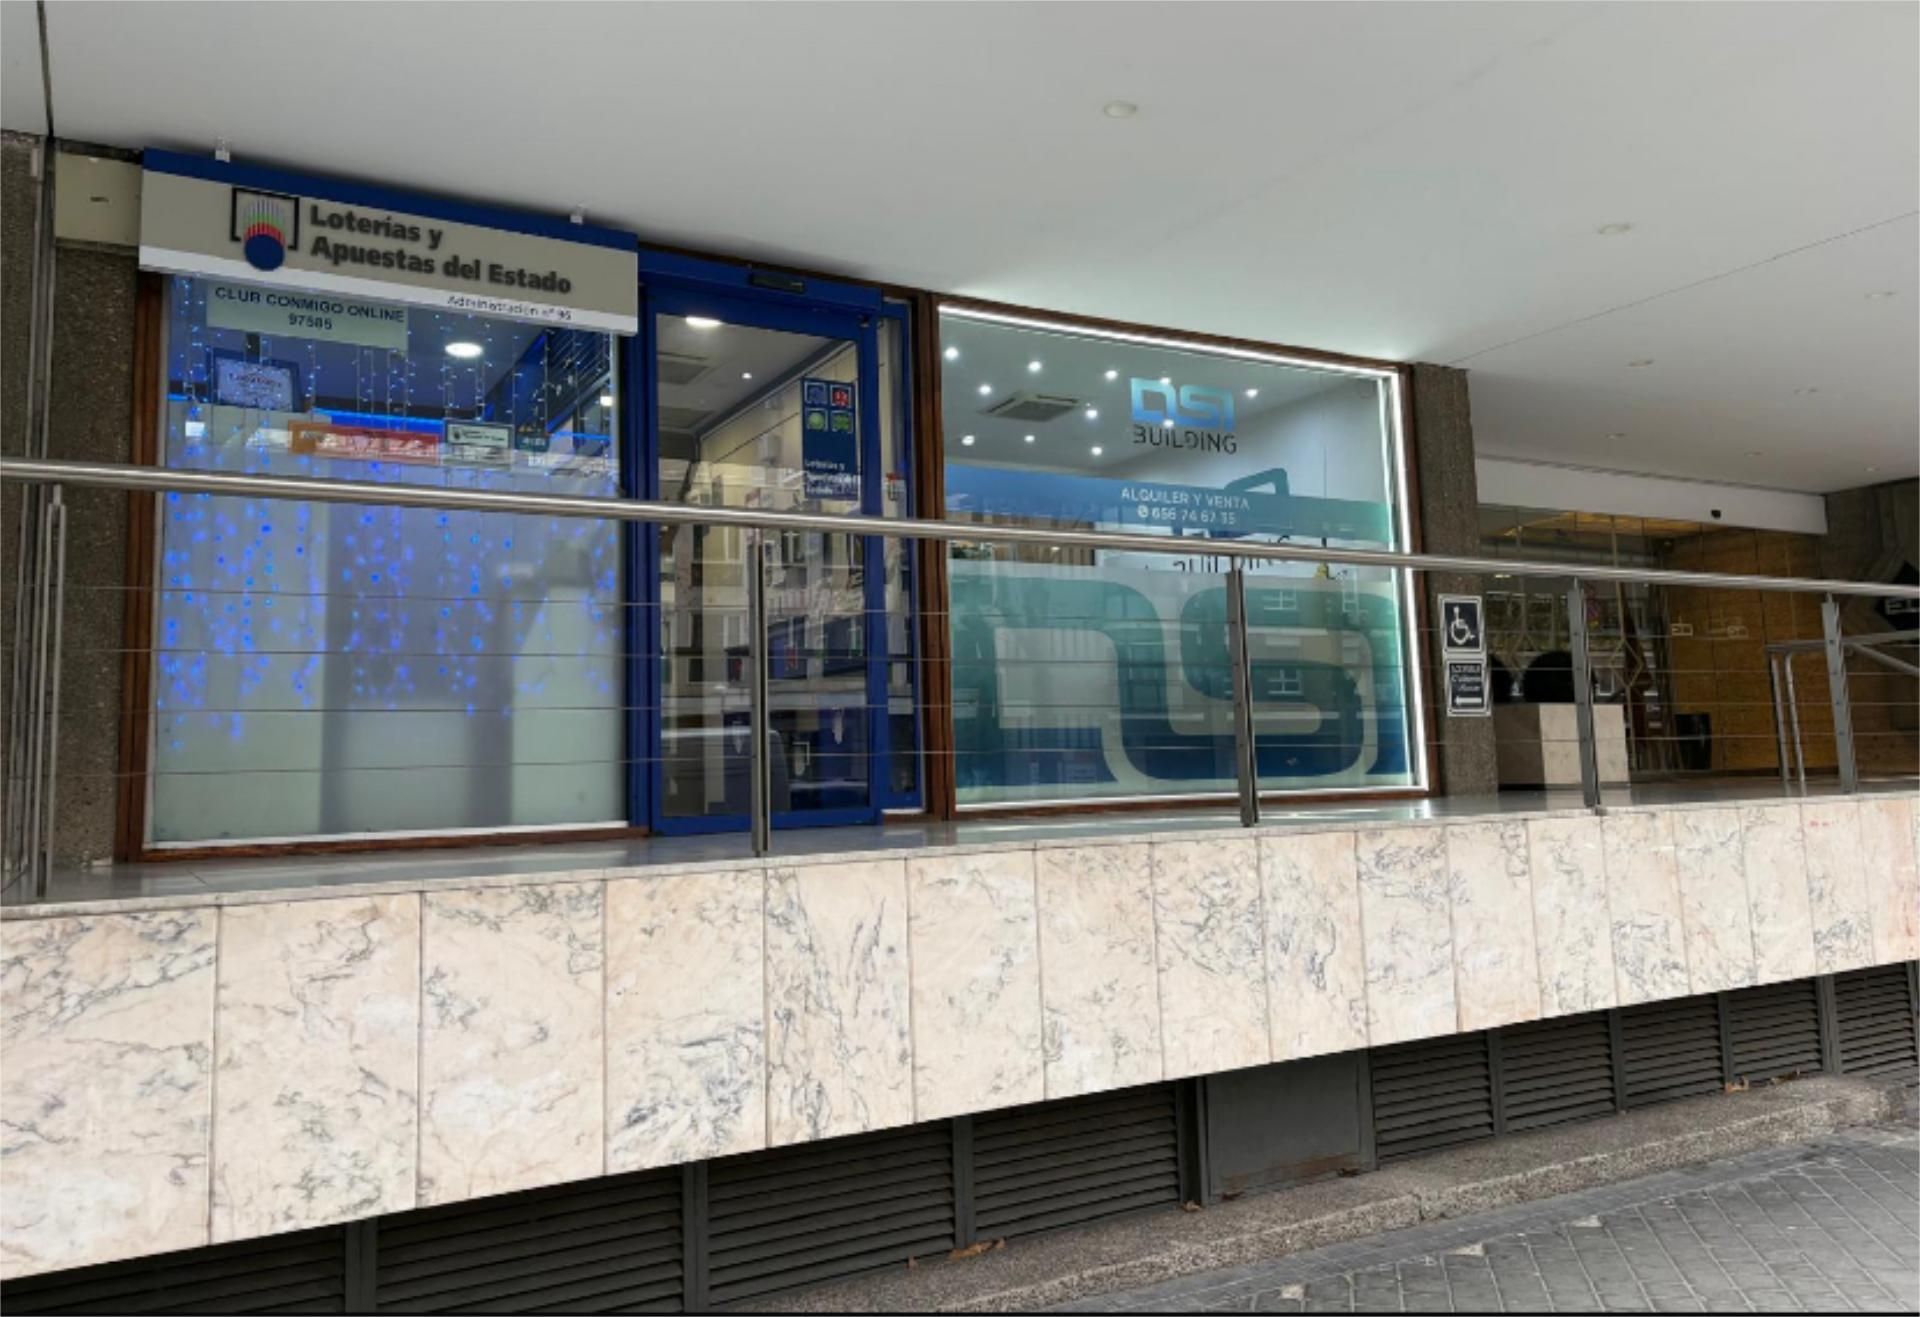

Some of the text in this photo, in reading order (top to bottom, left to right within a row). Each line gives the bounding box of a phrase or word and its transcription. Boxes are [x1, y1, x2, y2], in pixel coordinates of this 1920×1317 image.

[310, 204, 443, 250] Loterías y
[311, 235, 572, 294] Apuestas del Estado
[215, 286, 405, 324] CLUB CONMIGO ONLINE
[1121, 487, 1250, 511] ALQUILER Y VENTA
